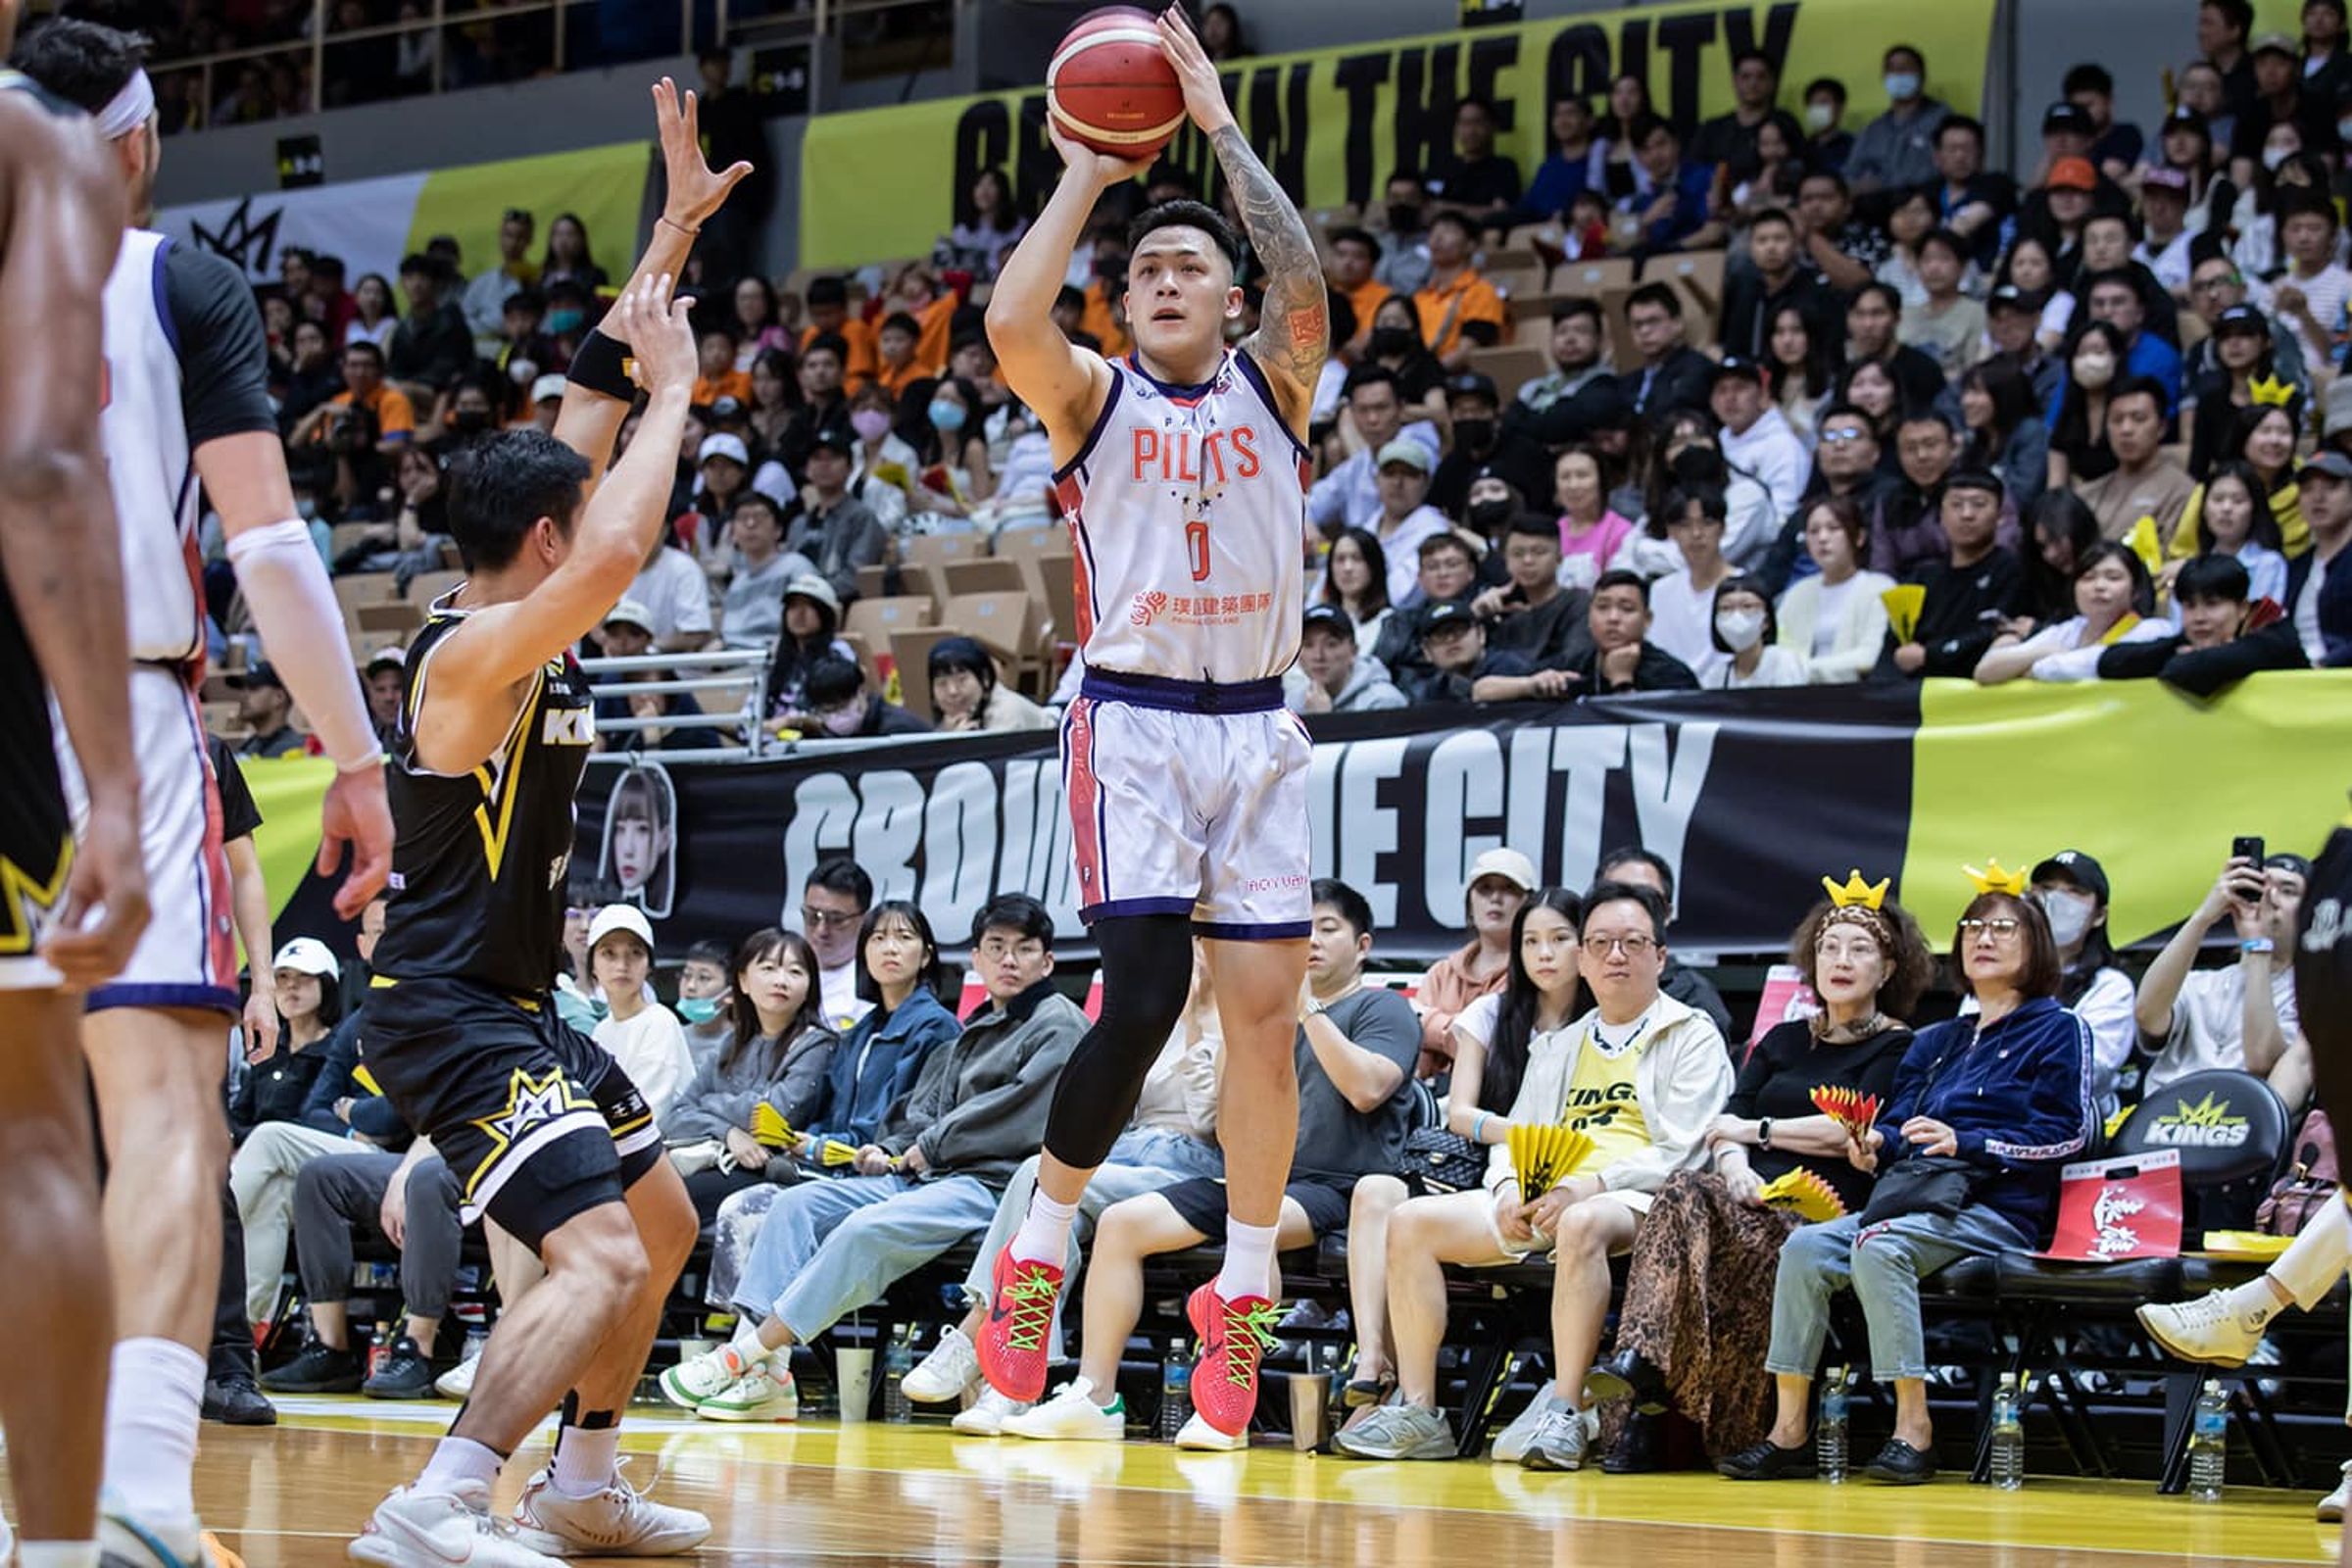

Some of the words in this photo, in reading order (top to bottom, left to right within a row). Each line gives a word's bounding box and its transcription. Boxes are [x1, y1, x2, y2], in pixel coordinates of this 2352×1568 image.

[1335, 34, 1521, 210] THE
[1544, 3, 1799, 159] CITY
[1133, 425, 1261, 483] PILTS
[1185, 520, 1211, 582] 0
[781, 757, 1092, 946] CROW
[1424, 722, 1721, 929] CITY
[2143, 1120, 2251, 1147] KINGS
